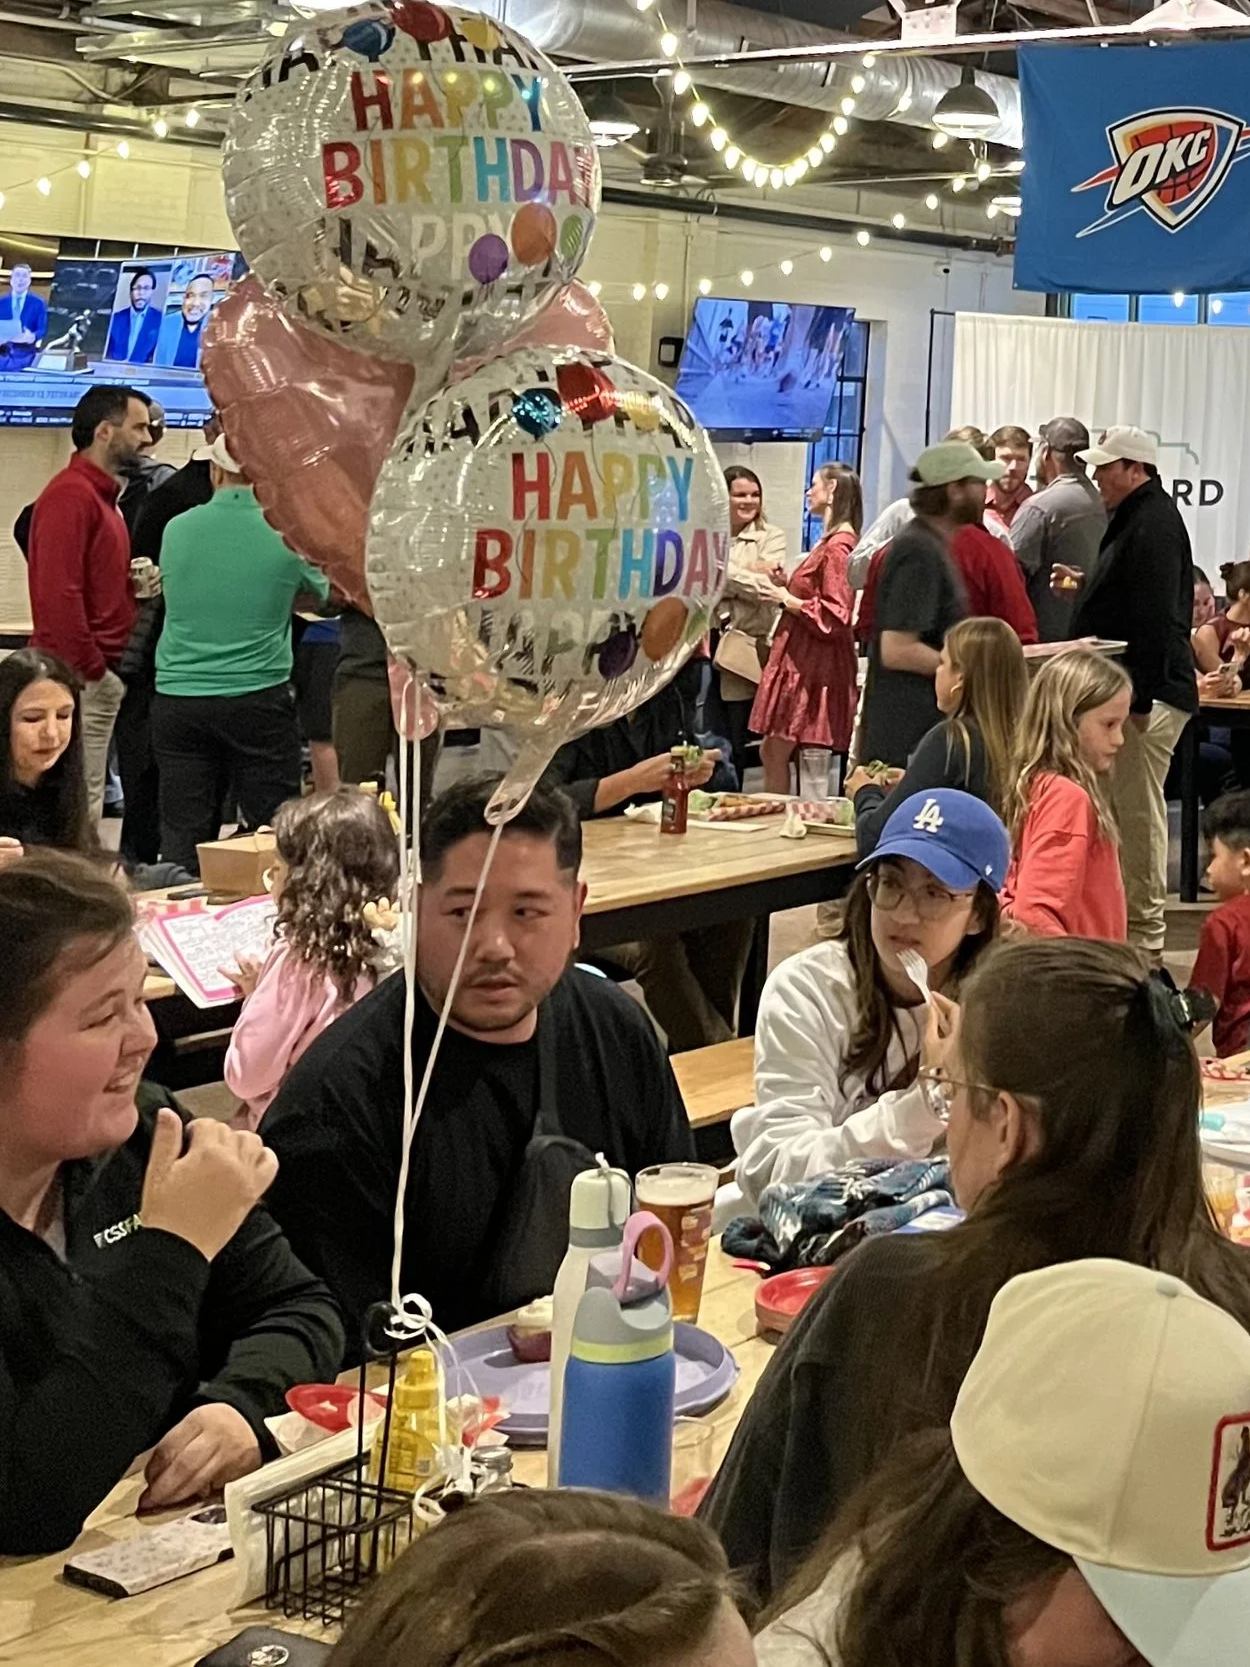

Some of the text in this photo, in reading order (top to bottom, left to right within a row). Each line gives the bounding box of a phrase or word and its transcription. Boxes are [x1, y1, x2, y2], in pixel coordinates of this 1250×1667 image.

[351, 70, 542, 132] HAPPY
[1112, 129, 1212, 205] OKC
[511, 451, 694, 522] HAPPY
[471, 527, 728, 600] BIRTHDAY
[912, 798, 945, 834] LA
